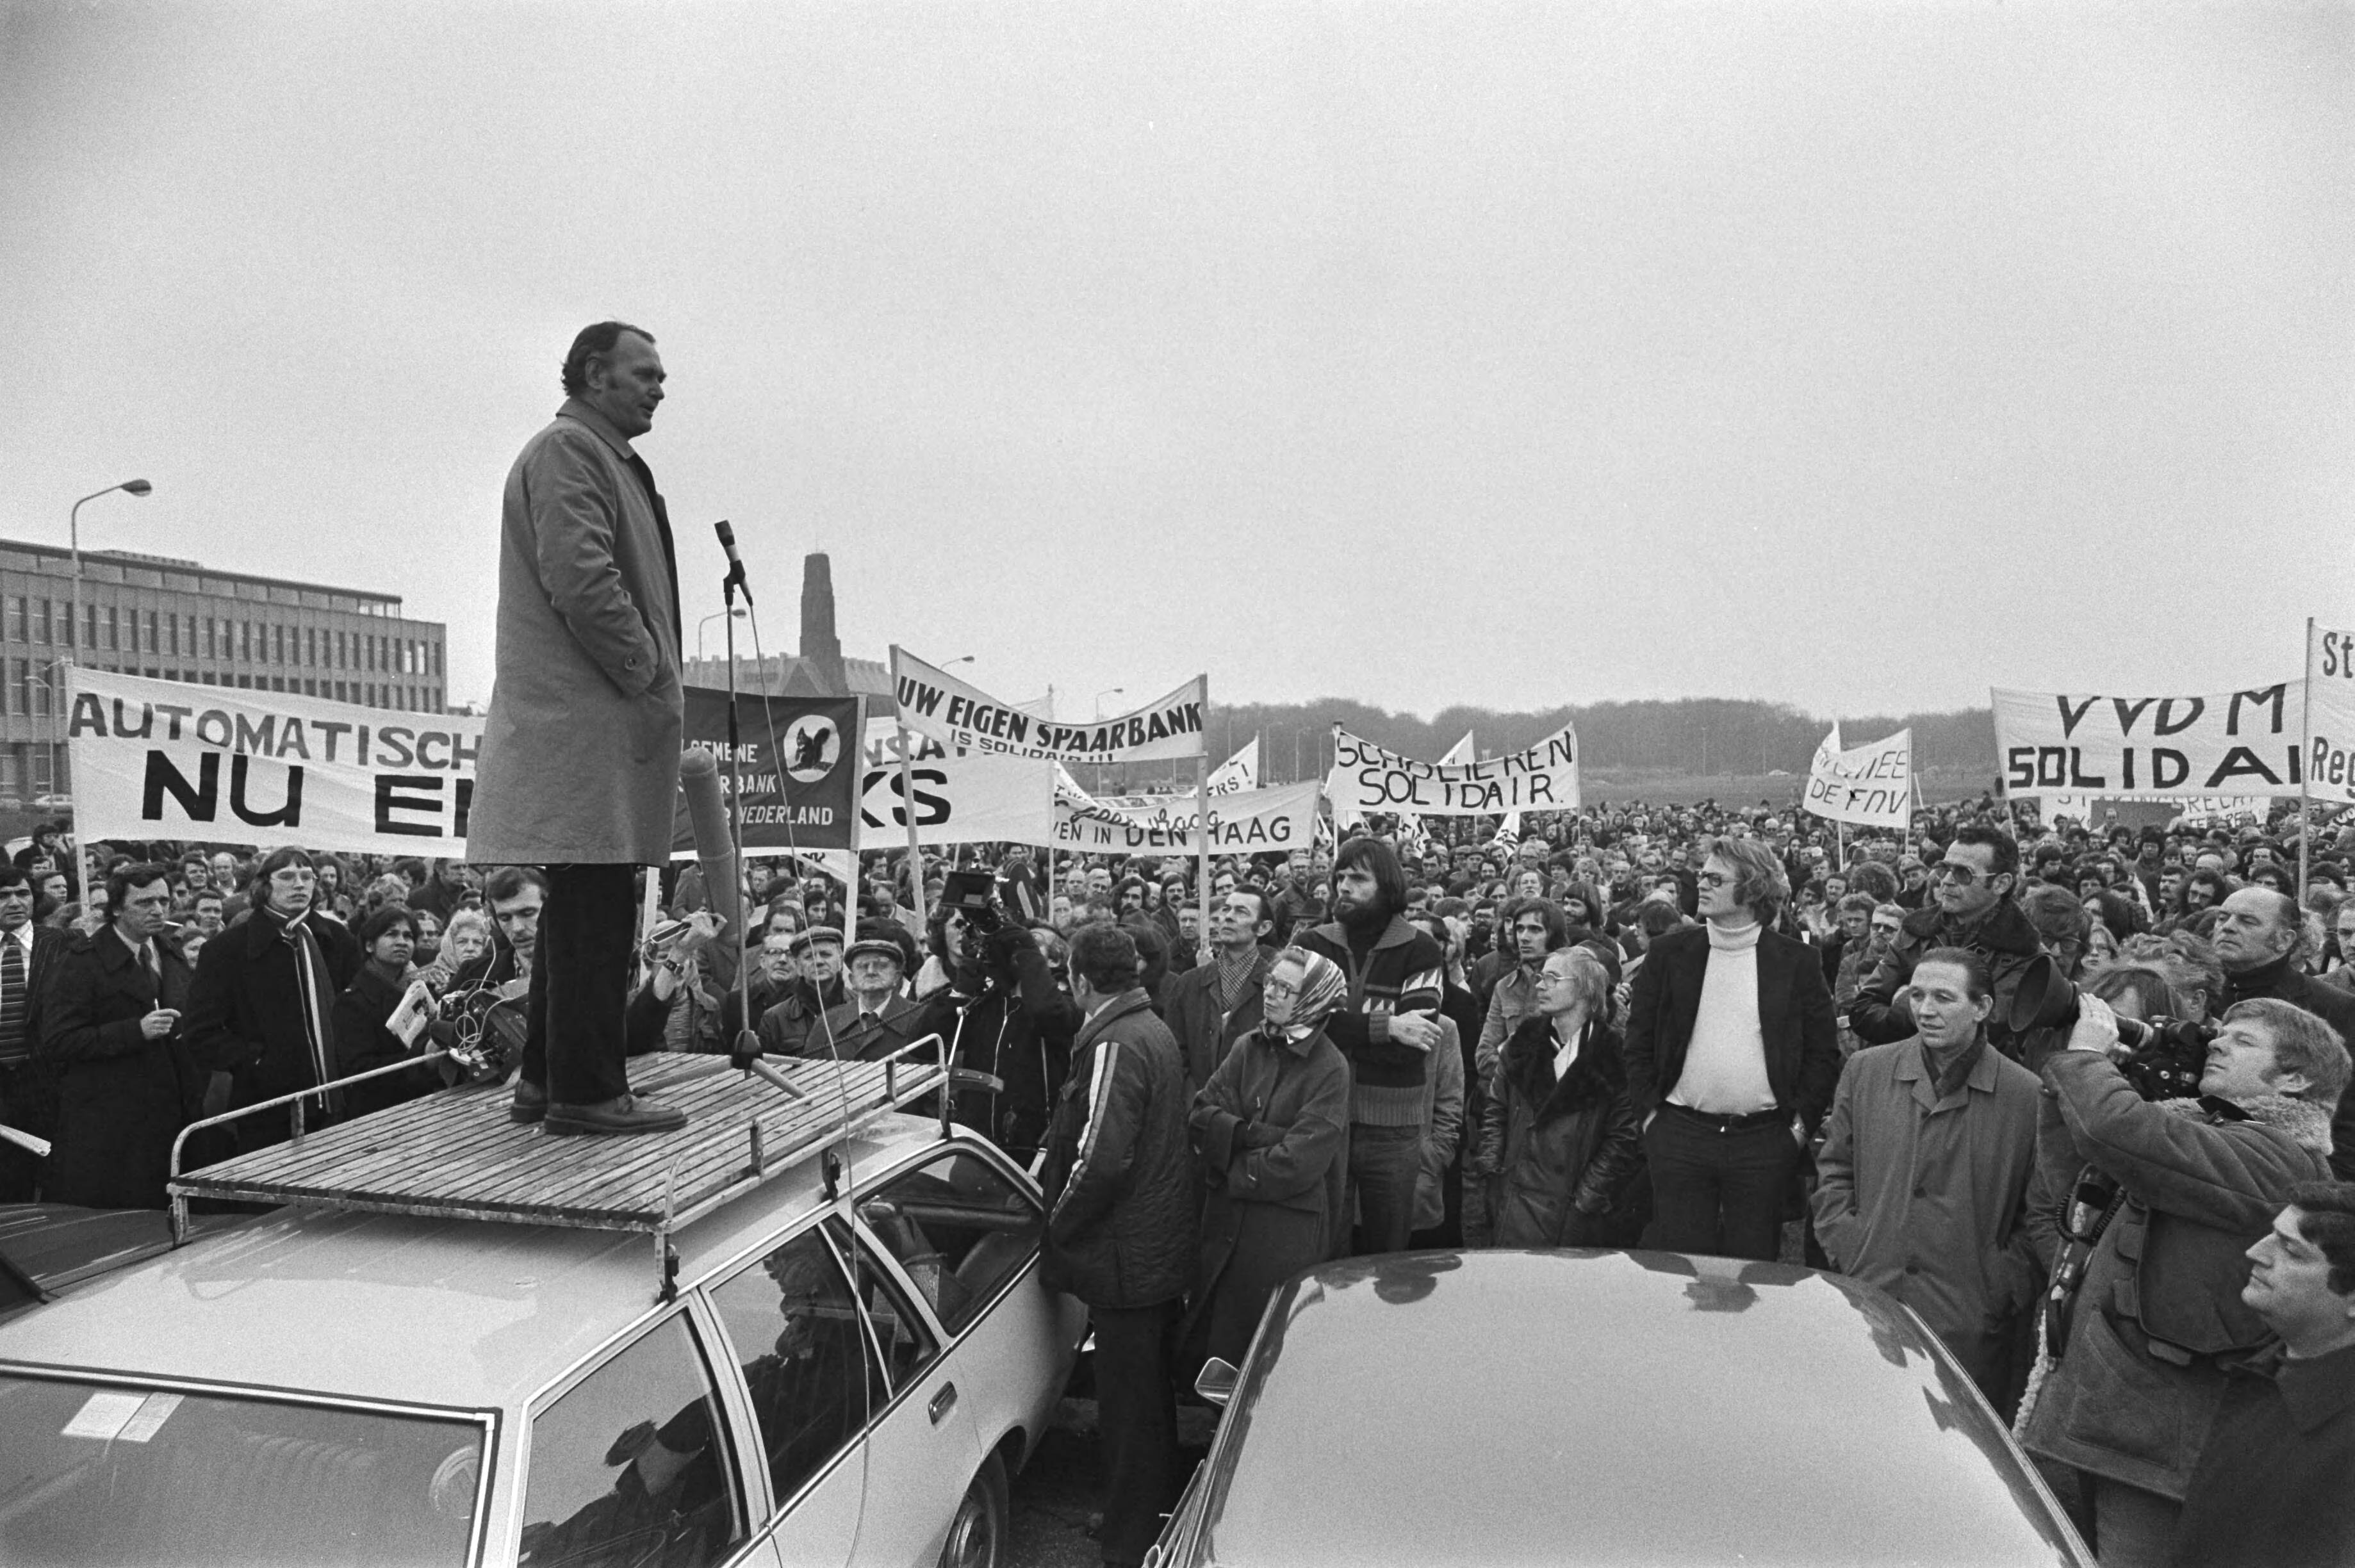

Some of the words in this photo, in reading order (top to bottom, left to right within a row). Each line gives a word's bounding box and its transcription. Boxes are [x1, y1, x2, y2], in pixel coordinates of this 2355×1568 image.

[897, 675, 945, 717] UW
[946, 695, 1029, 743] EIGEN
[1036, 701, 1203, 753] SPAARBANK
[951, 728, 972, 746] IS
[142, 749, 304, 828] NU
[1810, 778, 1842, 804] DE
[1094, 826, 1112, 845] IN
